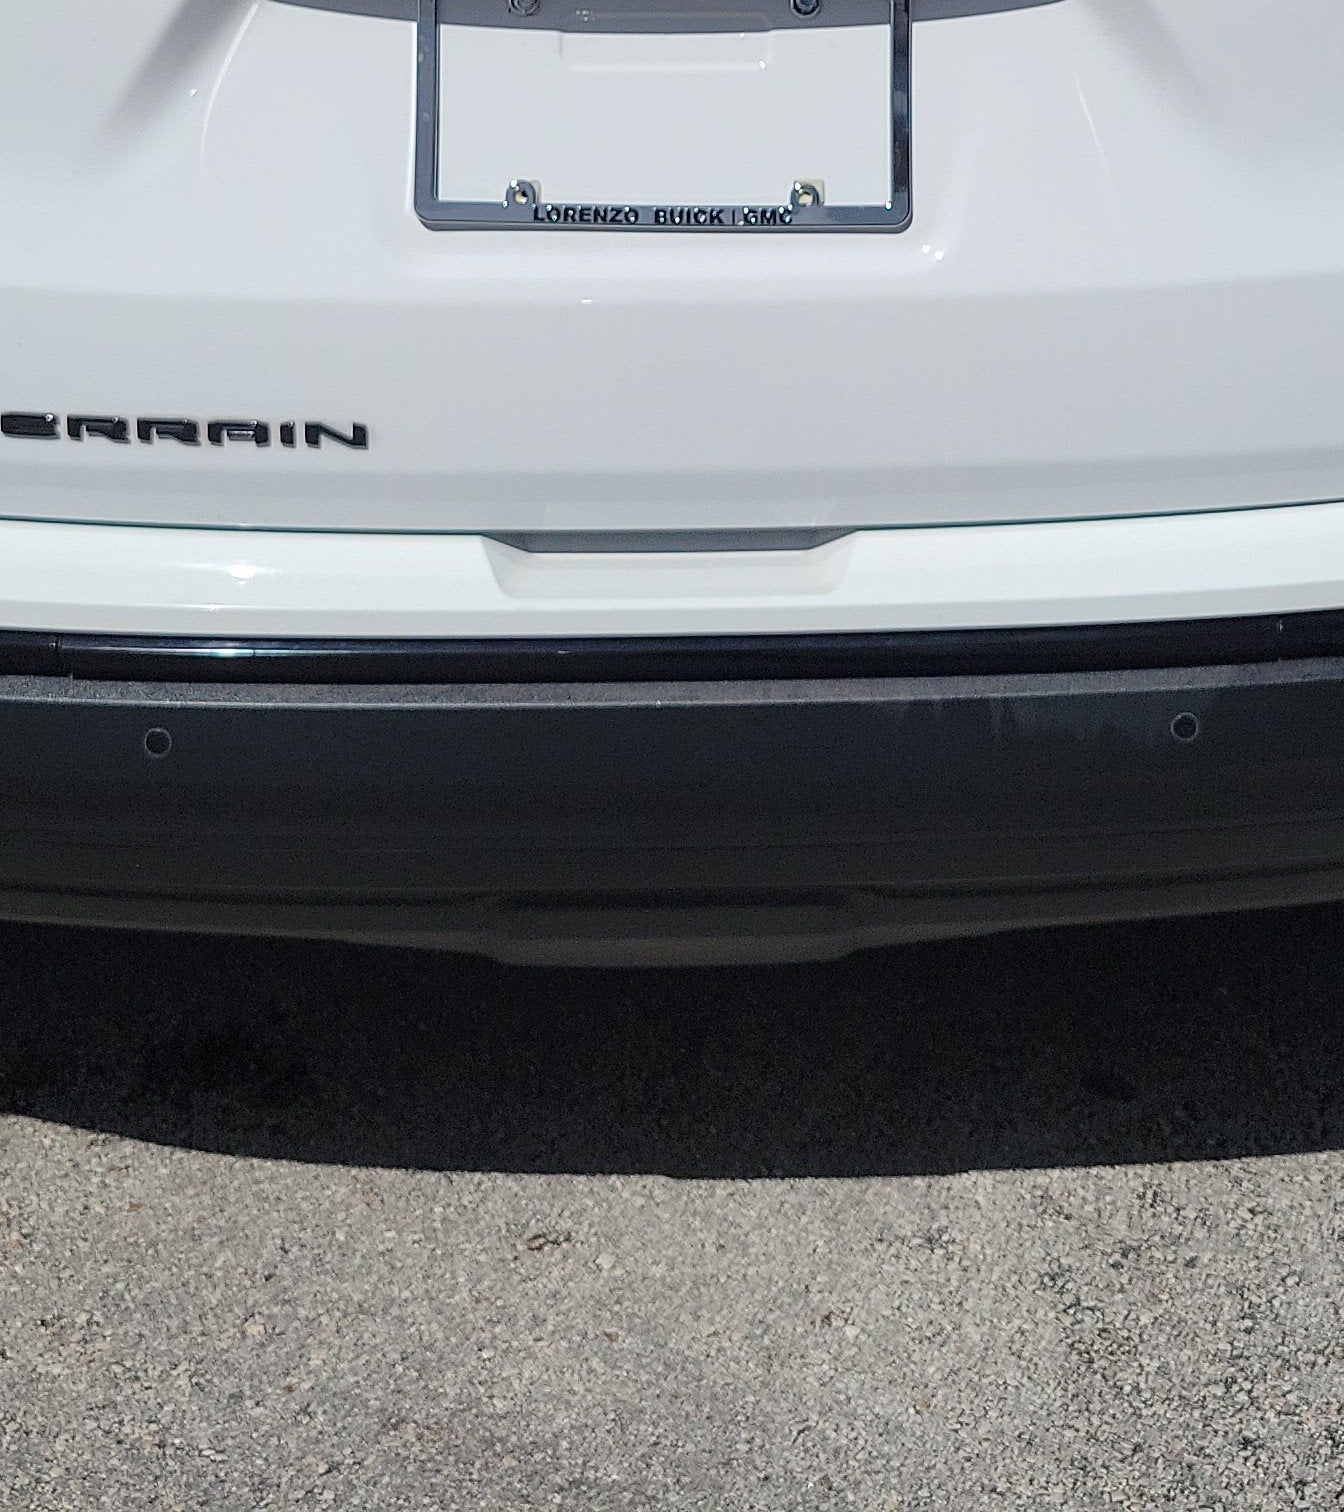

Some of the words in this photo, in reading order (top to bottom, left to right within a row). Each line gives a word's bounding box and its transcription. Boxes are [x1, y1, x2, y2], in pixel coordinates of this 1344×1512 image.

[532, 205, 640, 226] LORENZO
[654, 206, 725, 226] BUICK
[742, 207, 793, 227] GMC
